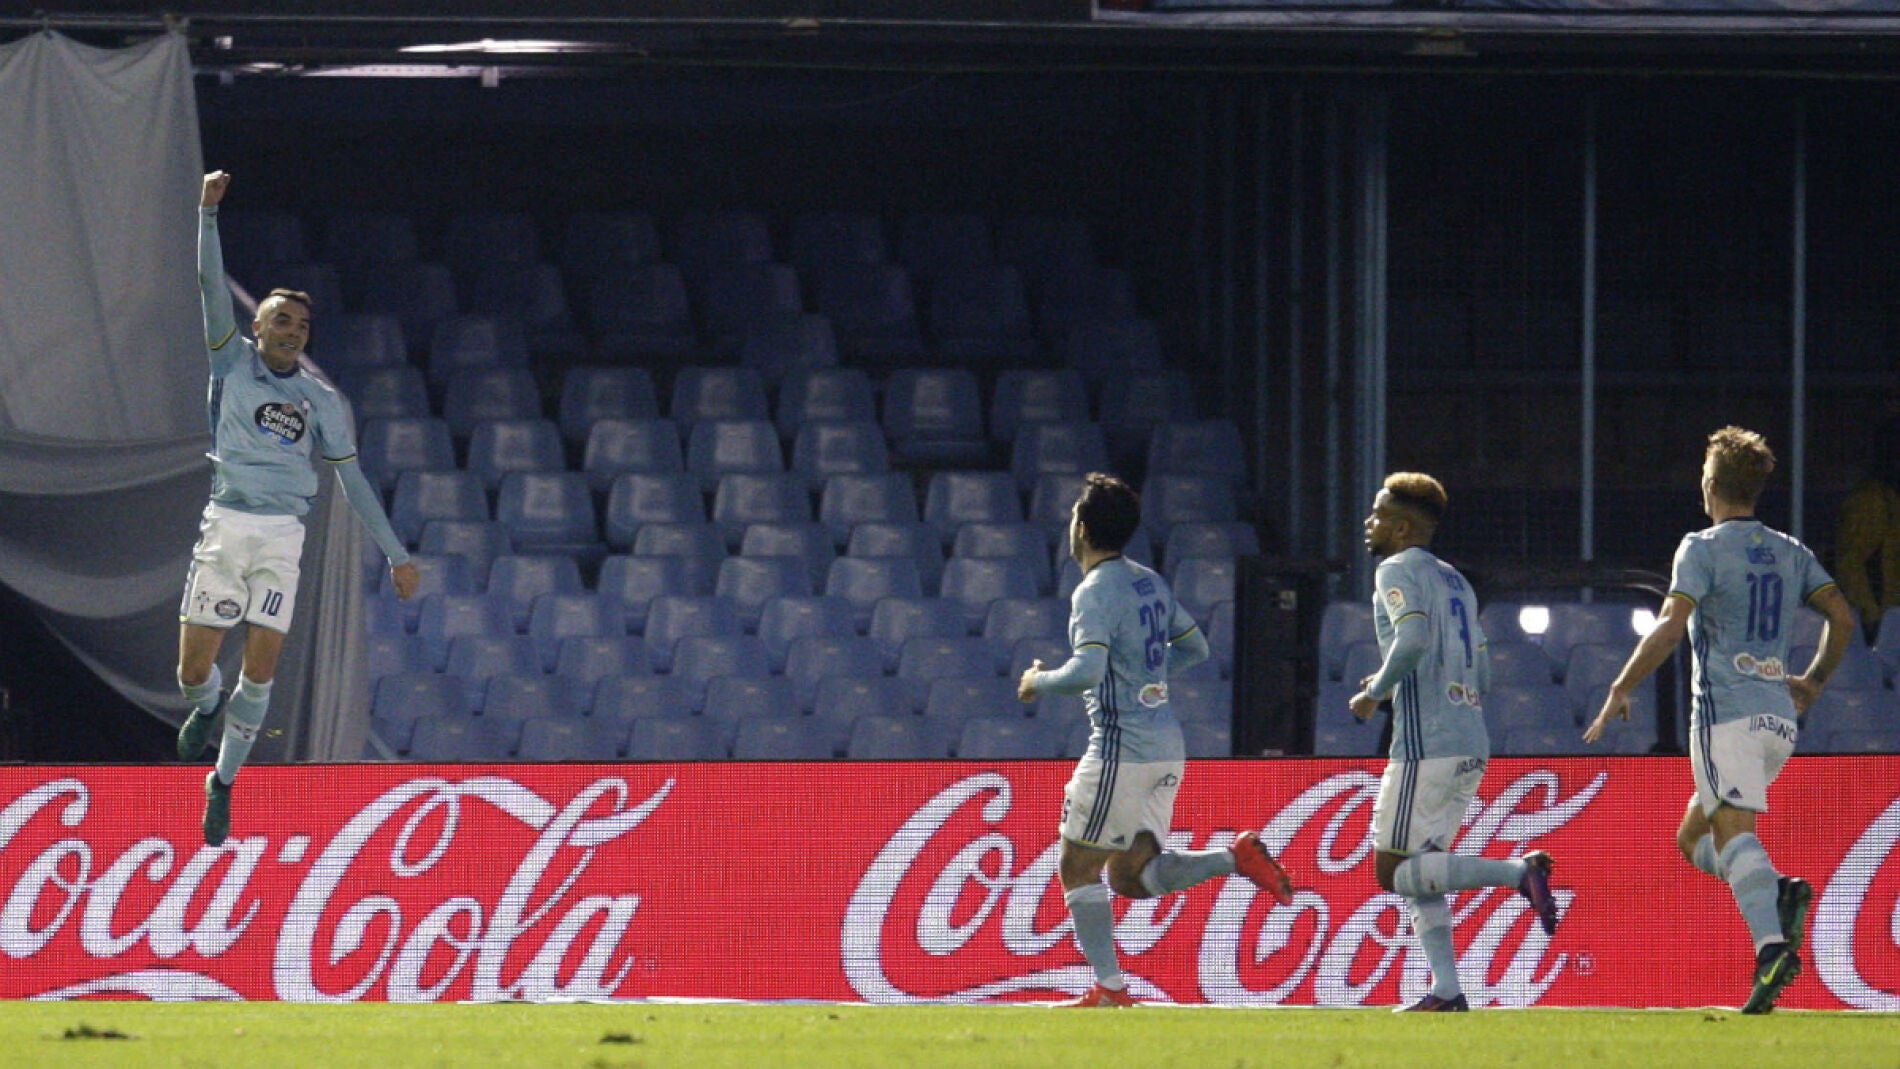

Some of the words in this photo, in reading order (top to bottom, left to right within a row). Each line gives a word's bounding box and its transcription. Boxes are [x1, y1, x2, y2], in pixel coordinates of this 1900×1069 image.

[260, 416, 297, 440] Galicia
[262, 404, 304, 431] Estrella
[261, 588, 283, 616] 10
[1746, 571, 1784, 642] 18
[1449, 597, 1473, 668] 7
